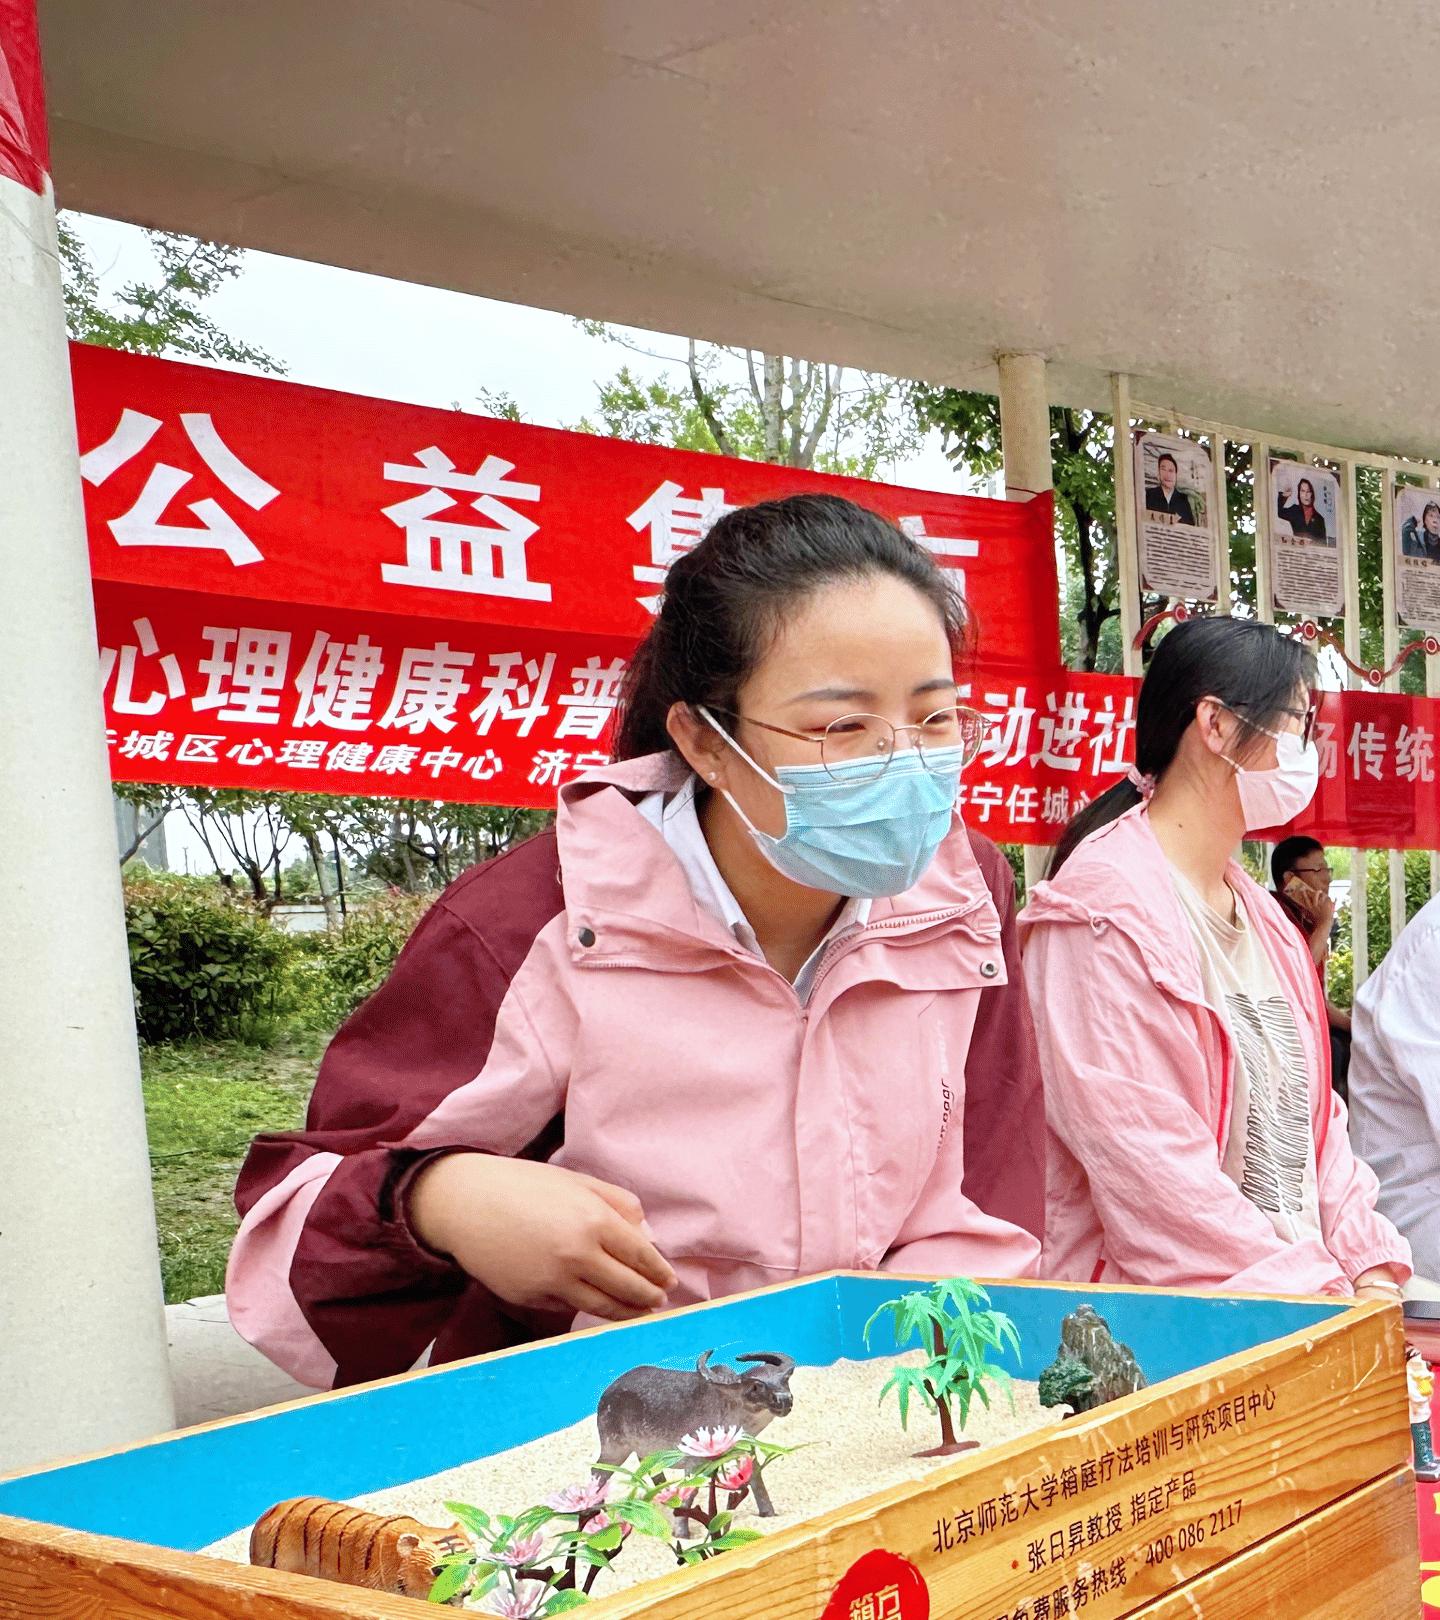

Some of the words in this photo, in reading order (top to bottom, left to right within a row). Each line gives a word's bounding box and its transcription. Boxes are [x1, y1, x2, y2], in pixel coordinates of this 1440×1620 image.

[100, 617, 626, 740] 心理健康科普
[958, 685, 1136, 776] 动进社
[932, 1383, 1277, 1553] 北京师范大学箱庭疗法培训与研究项目中心
[1129, 1470, 1197, 1526] 指定产品
[1145, 1536, 1174, 1568] 400
[1178, 1518, 1205, 1552] 086
[1208, 1499, 1243, 1537] 2117
